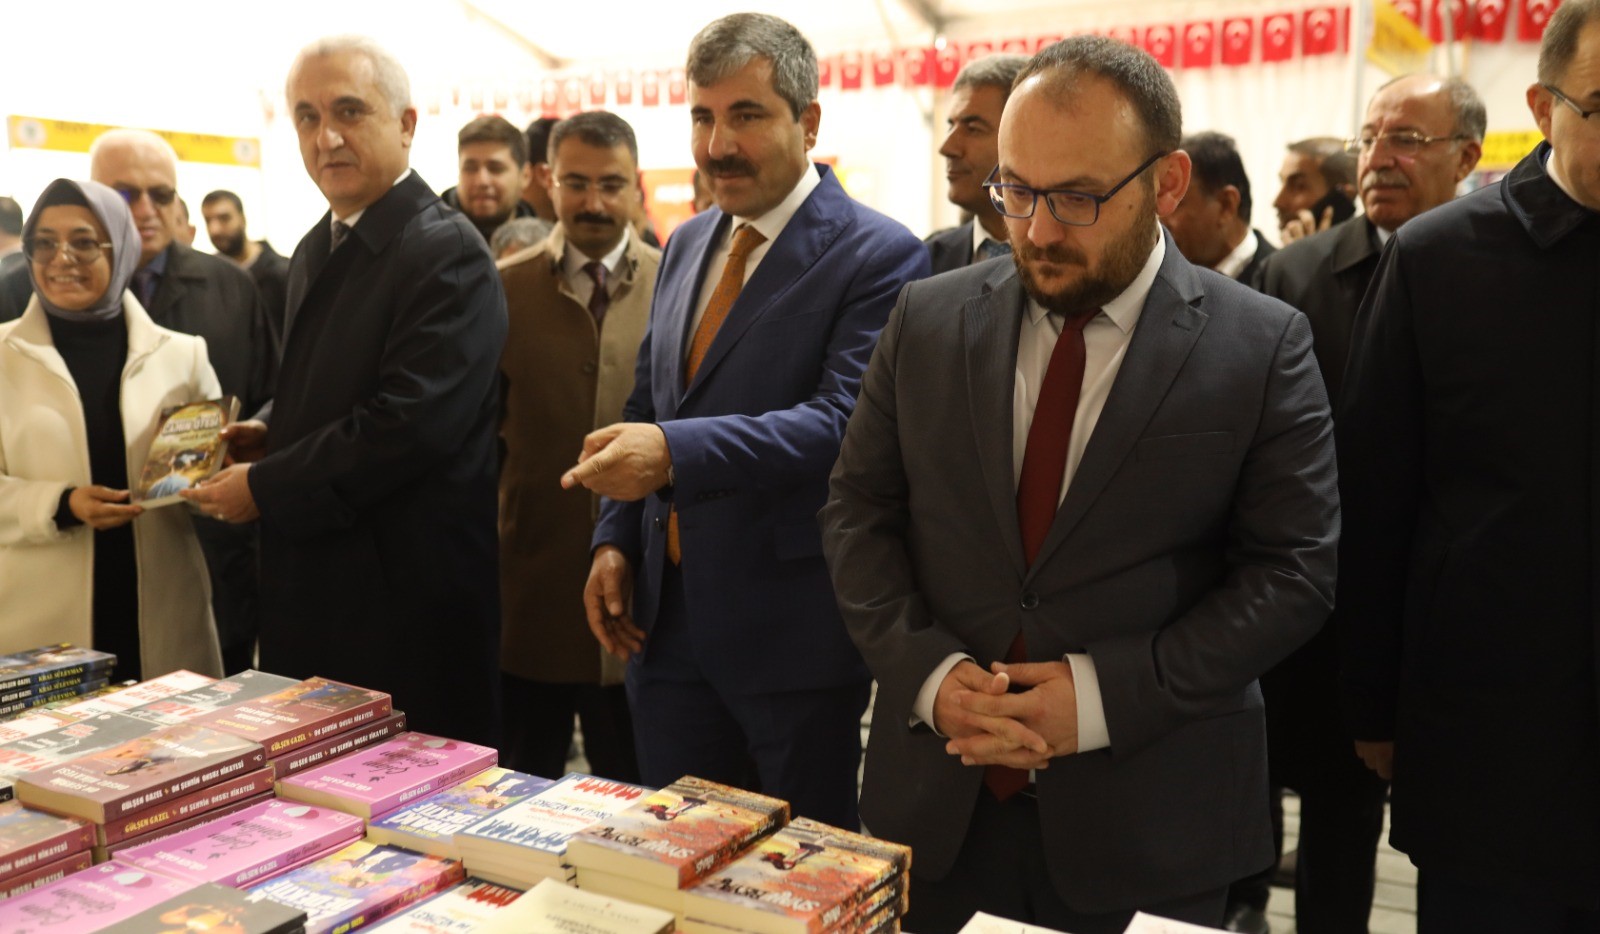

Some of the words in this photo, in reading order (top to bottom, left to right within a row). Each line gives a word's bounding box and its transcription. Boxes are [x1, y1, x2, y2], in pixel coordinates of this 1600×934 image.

[271, 740, 291, 752] GÜLŞEN
[291, 733, 306, 746] GAZEL
[321, 723, 338, 735] ŞEHRİN
[289, 758, 308, 769] GÜLŞEN
[309, 751, 323, 763] GAZEL
[337, 740, 353, 753] ŞEHRİN
[121, 797, 144, 811] GÜLŞEN
[145, 789, 163, 803] GAZEL
[171, 785, 180, 793] ON
[180, 776, 200, 791] ŞEHRİN
[202, 770, 219, 782] ONSUZ
[220, 760, 244, 775] HİKAYESİ
[125, 818, 149, 833] GÜLŞEN
[149, 811, 170, 825] GAZEL
[180, 806, 188, 815] ON
[189, 797, 210, 812] ŞEHRİN
[211, 792, 229, 804] ONSUZ
[230, 782, 255, 797] HİKAYESİ
[411, 802, 476, 825] EDEKTİF
